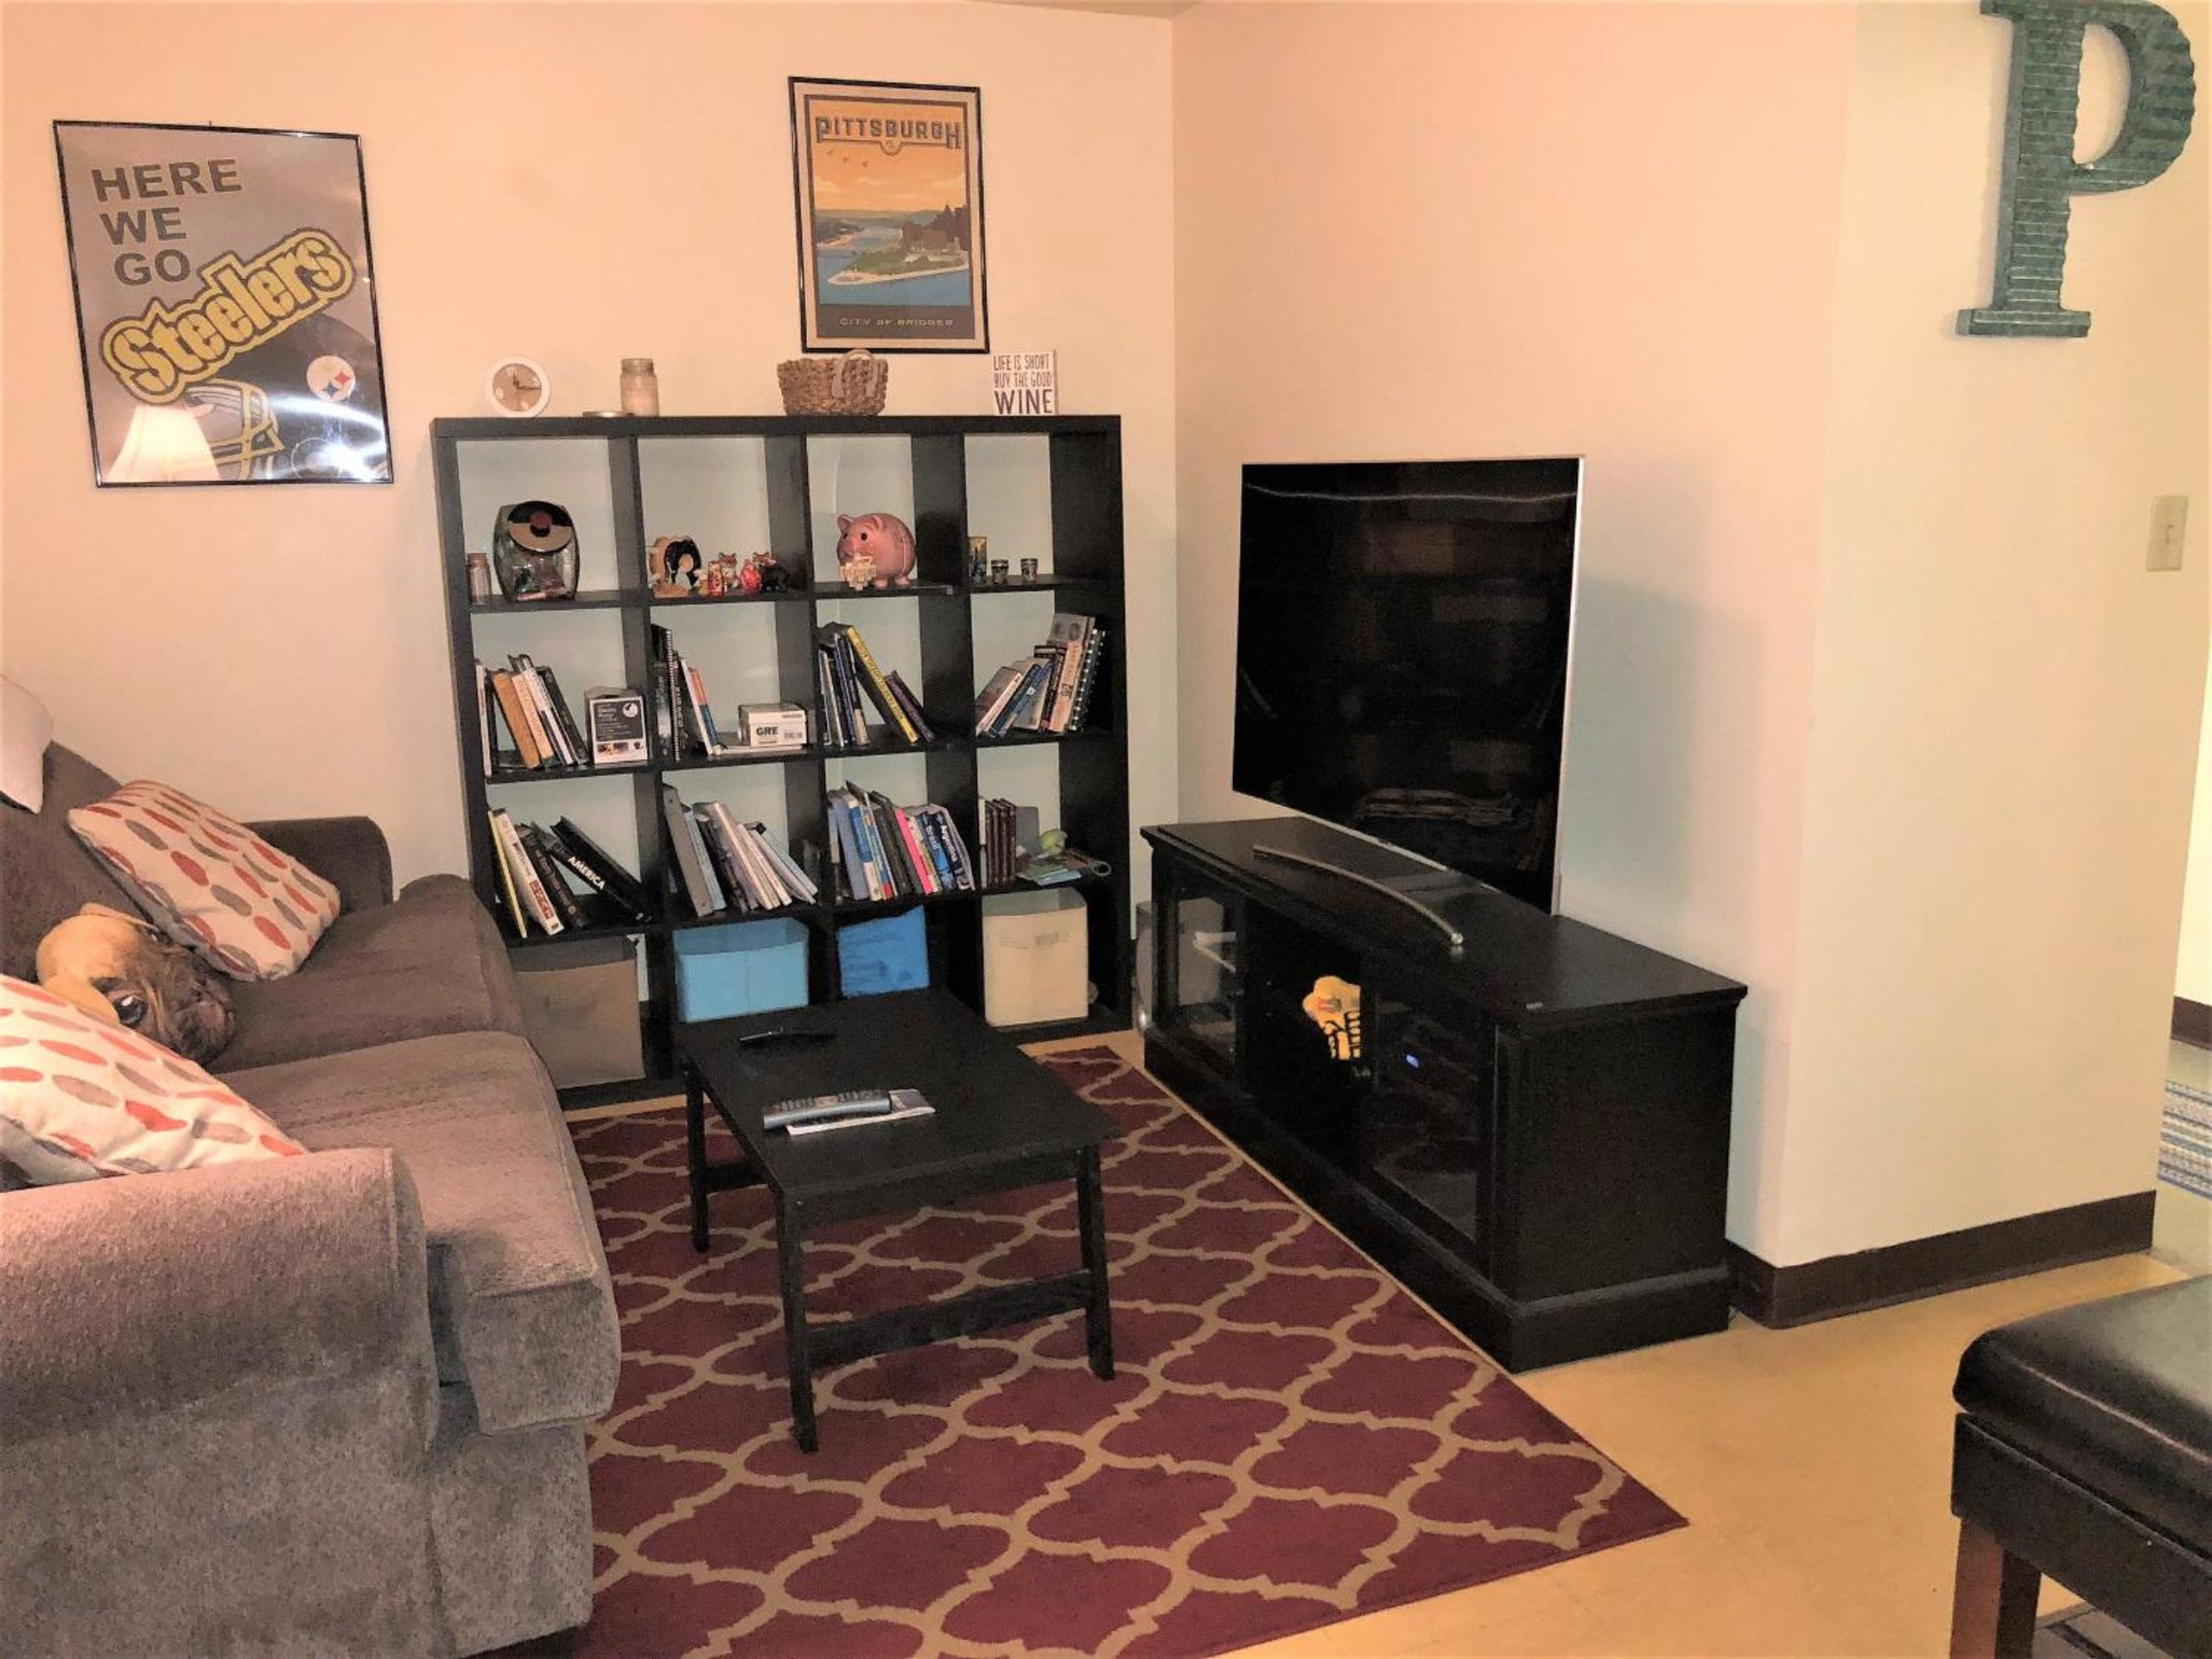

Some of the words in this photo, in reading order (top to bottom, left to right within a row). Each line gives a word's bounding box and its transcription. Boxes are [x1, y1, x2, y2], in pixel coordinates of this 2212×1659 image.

[815, 115, 962, 149] PITTSBURGH
[92, 159, 242, 202] HERE
[1956, 0, 2196, 338] P
[99, 207, 188, 247] WE
[114, 248, 191, 286] GO
[103, 229, 353, 402] Steelers
[839, 317, 871, 326] CITY
[993, 354, 1011, 372] LIFE
[1014, 354, 1021, 371] IS
[1024, 353, 1050, 371] SHORT
[994, 372, 1011, 389] BUY
[1014, 372, 1028, 388] THE
[1030, 371, 1052, 387] GOOD
[994, 389, 1053, 415] WINE
[755, 726, 779, 736] GRE
[567, 856, 605, 890] AMERICA
